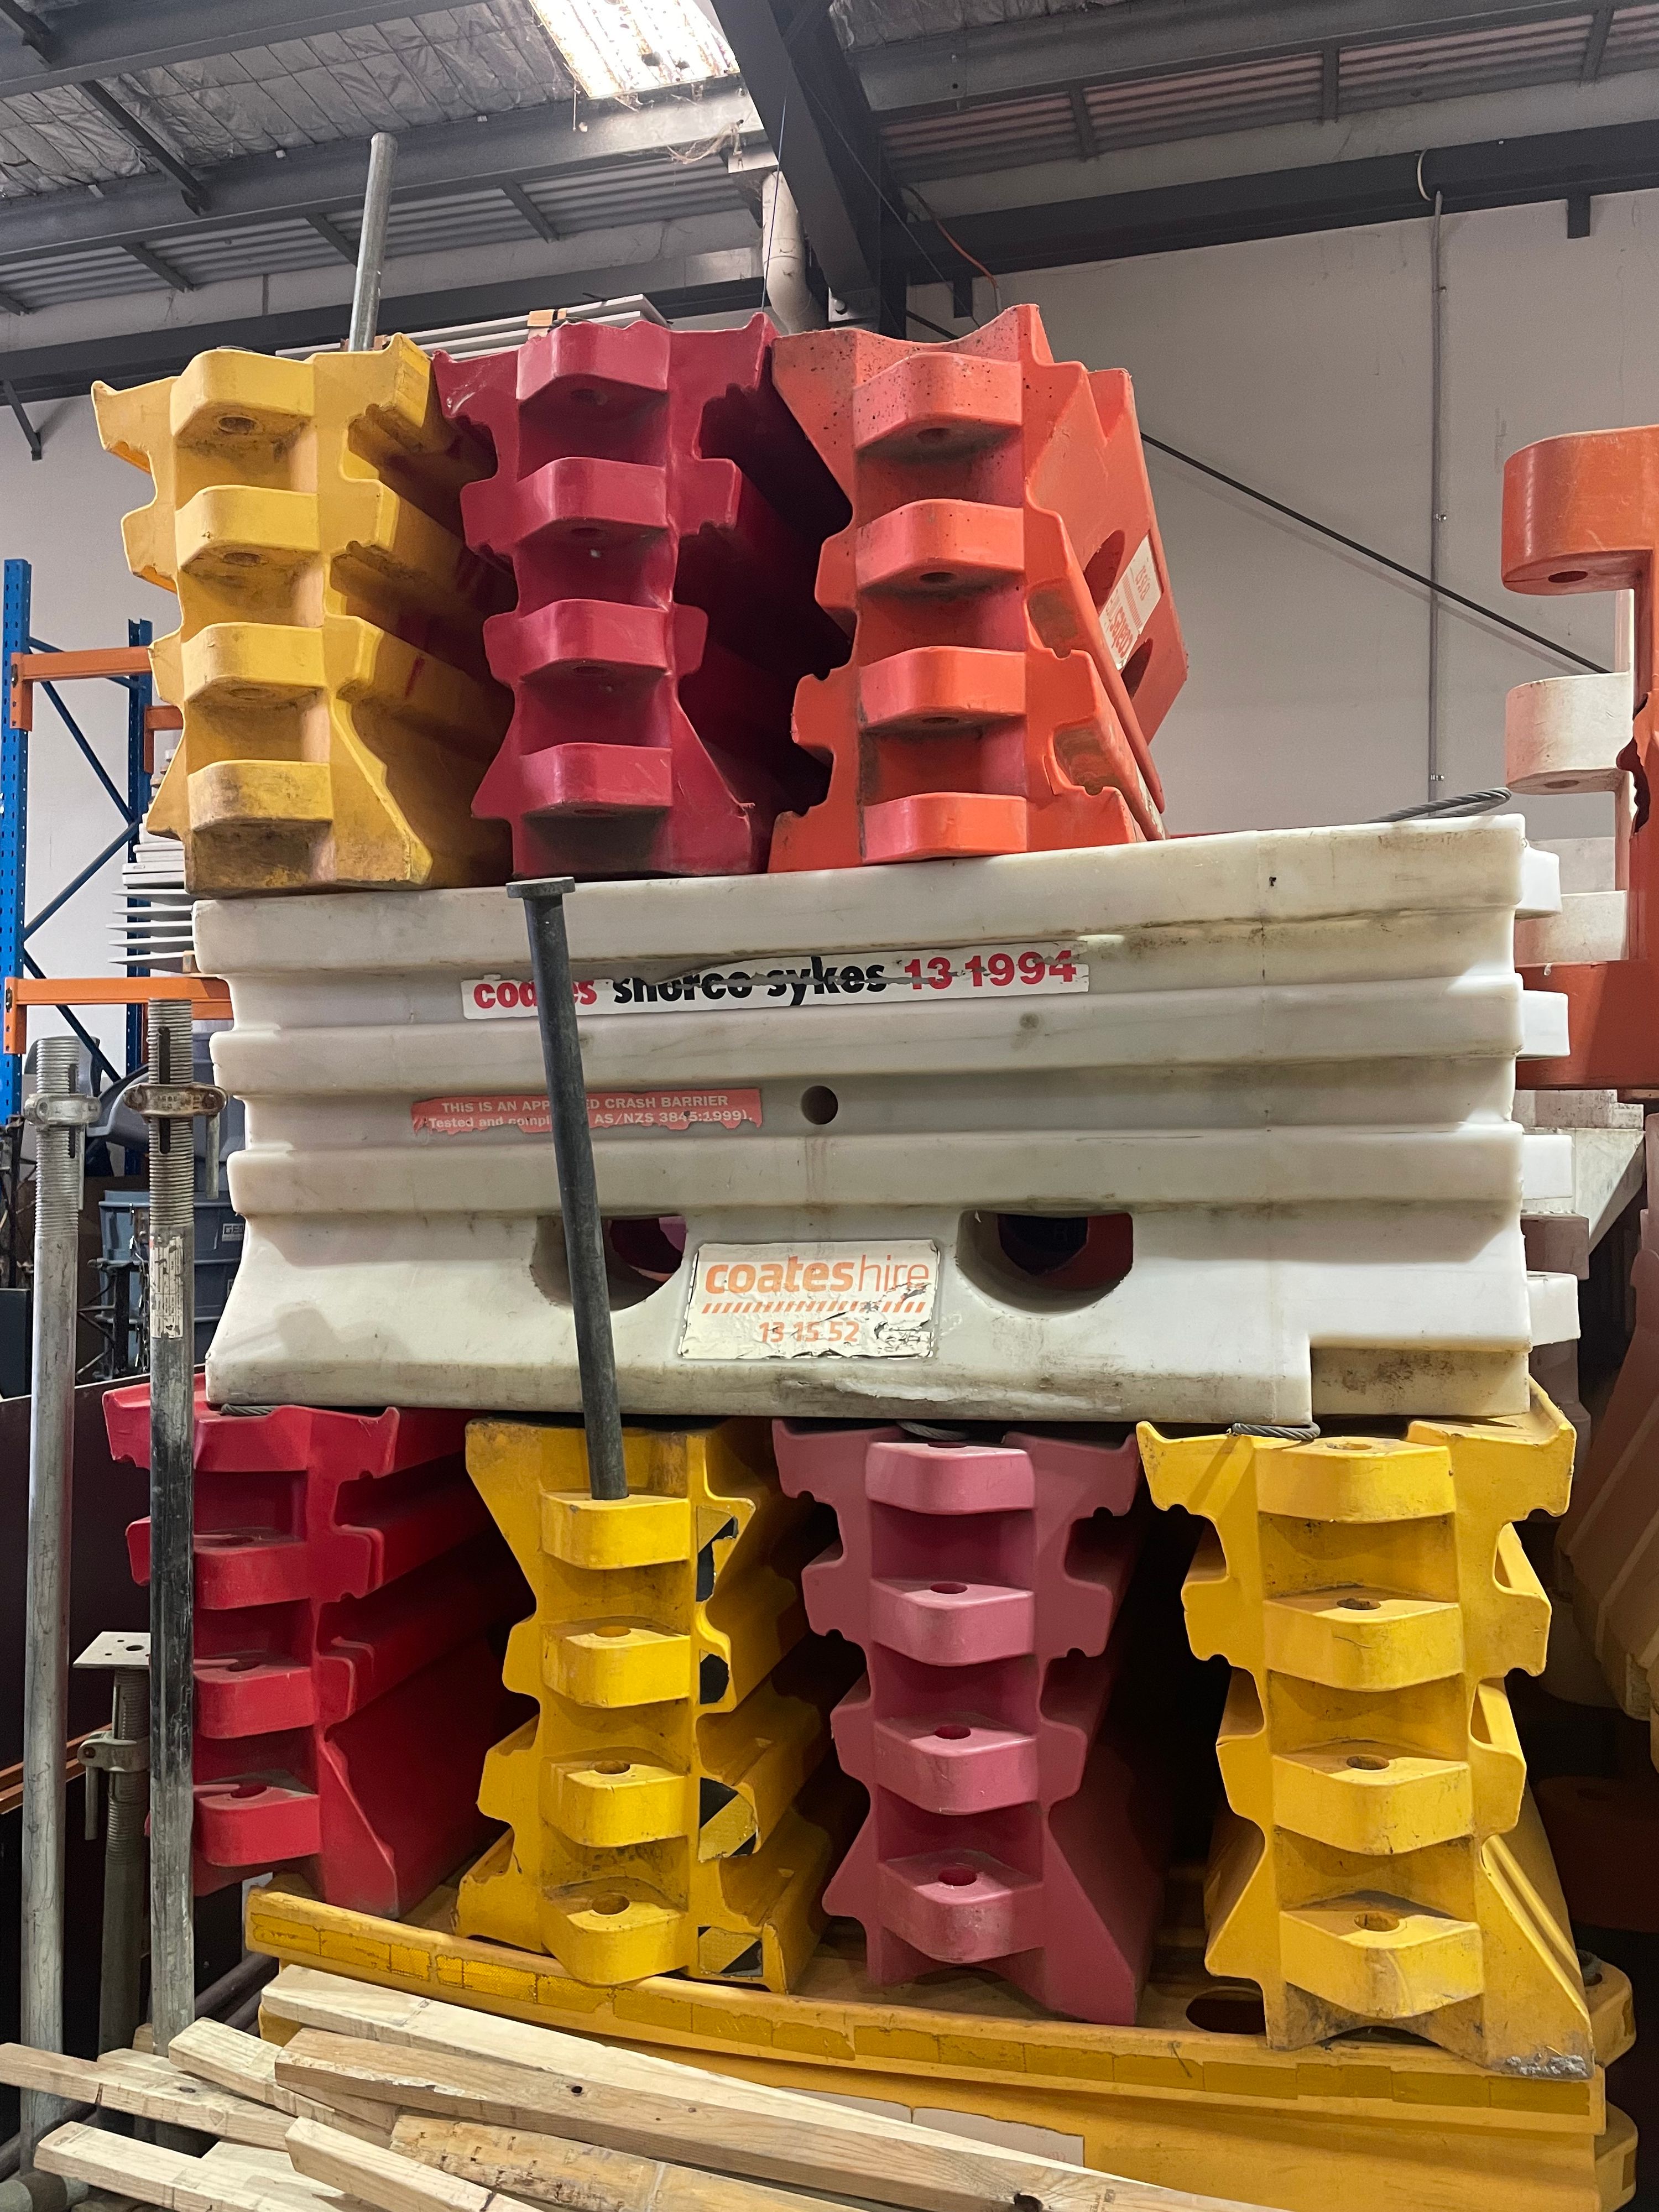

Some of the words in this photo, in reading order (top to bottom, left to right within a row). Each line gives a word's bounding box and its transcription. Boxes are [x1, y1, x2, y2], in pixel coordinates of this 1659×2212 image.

[473, 980, 597, 1009] coas
[767, 956, 887, 1006] sykes
[904, 957, 952, 990] 13
[964, 950, 1077, 987] 1994
[442, 1102, 474, 1114] THIS
[479, 1102, 492, 1112] IS
[498, 1100, 517, 1112] AN
[605, 1097, 655, 1109] CRASH
[661, 1095, 728, 1107] BARRIER
[479, 1116, 503, 1126] and
[594, 1112, 654, 1125] AS/NZS
[759, 1322, 784, 1343] 13
[794, 1322, 819, 1343] 15
[828, 1321, 859, 1343] 52
